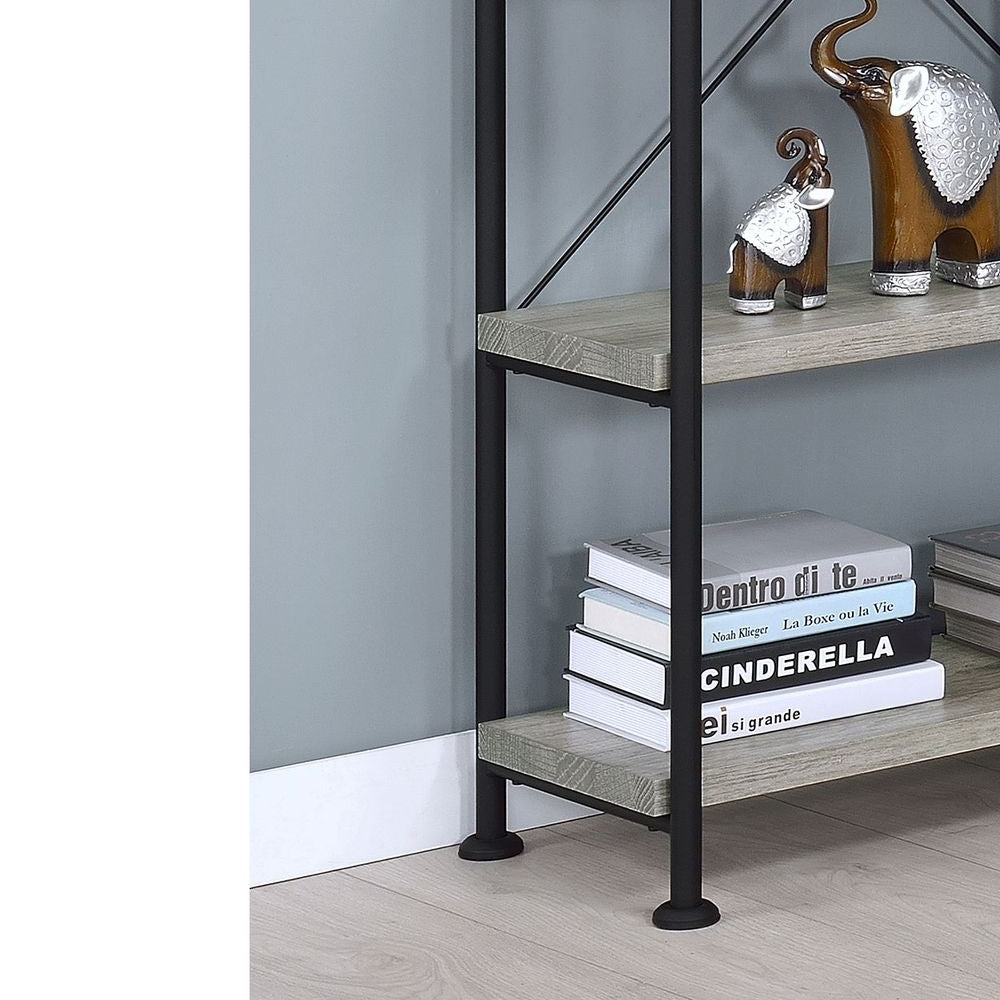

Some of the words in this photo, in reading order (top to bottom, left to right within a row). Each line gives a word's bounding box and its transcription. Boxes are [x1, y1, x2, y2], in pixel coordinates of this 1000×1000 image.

[702, 575, 785, 612] Dentro
[794, 565, 818, 597] di
[832, 562, 857, 591] te
[711, 631, 737, 644] Noah
[738, 626, 769, 639] Klieger
[782, 618, 800, 631] La
[804, 612, 835, 626] Boxe
[839, 610, 855, 620] ou
[858, 605, 870, 617] la
[873, 601, 894, 614] Vie
[700, 635, 894, 692] CINDERELLA
[702, 706, 727, 738] ei
[731, 717, 744, 732] si
[748, 708, 801, 732] grande
